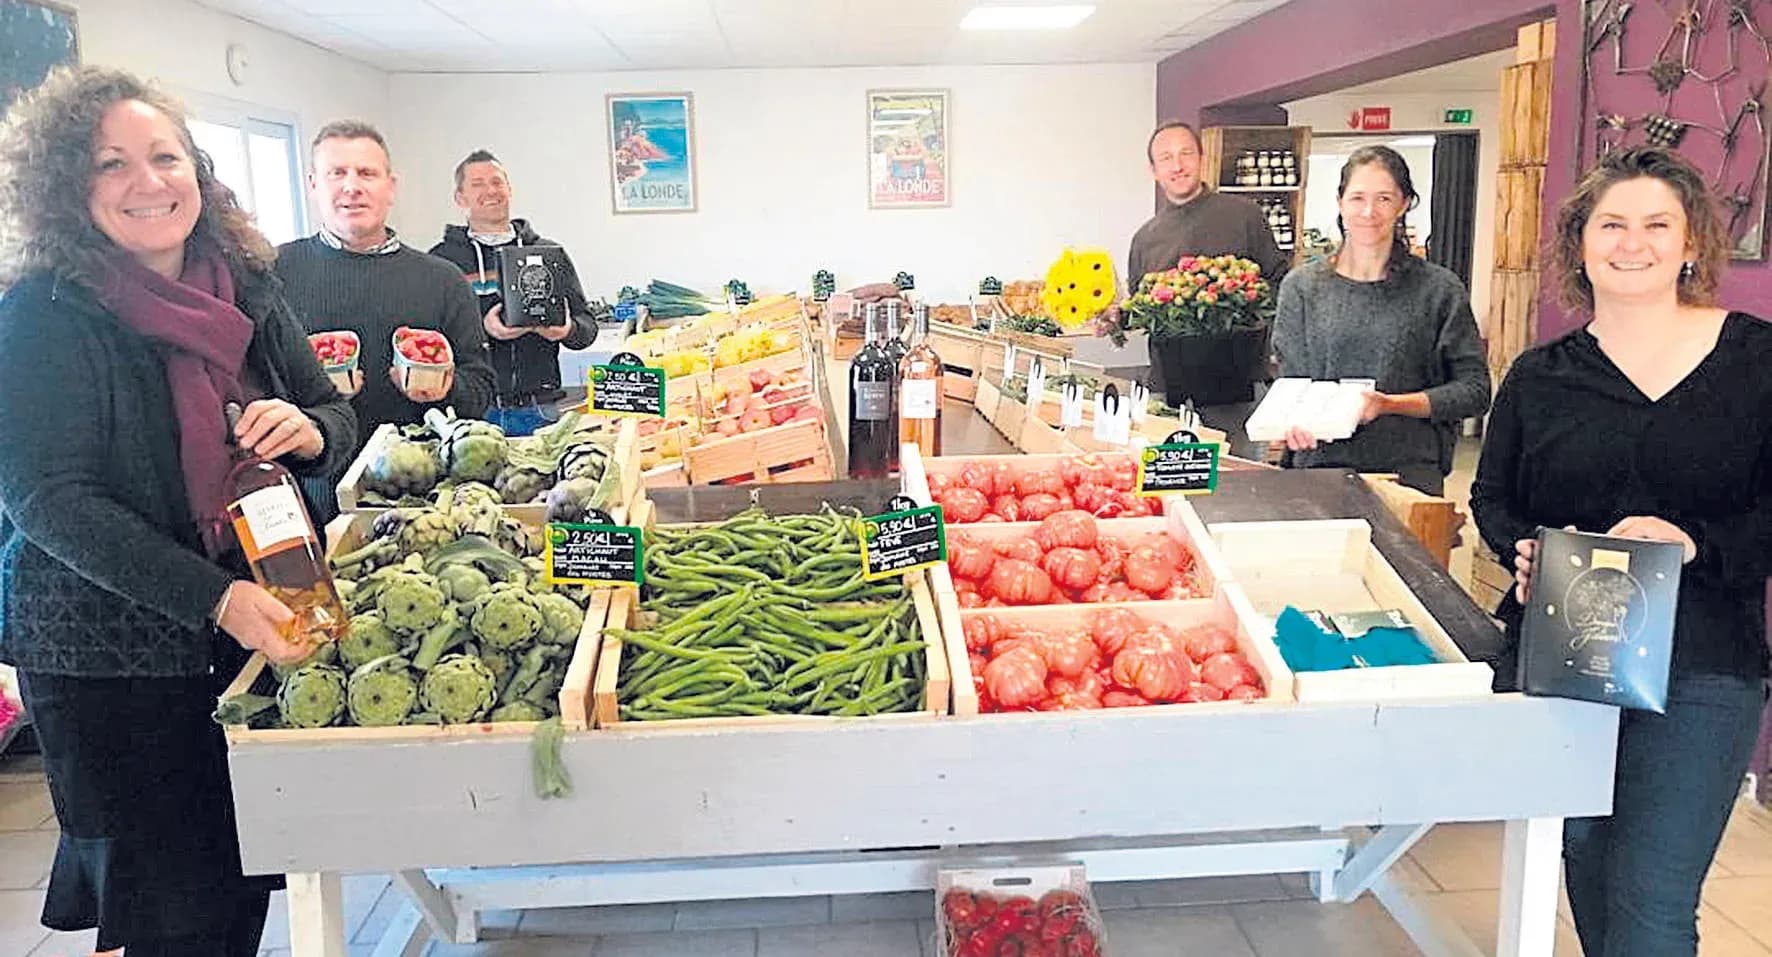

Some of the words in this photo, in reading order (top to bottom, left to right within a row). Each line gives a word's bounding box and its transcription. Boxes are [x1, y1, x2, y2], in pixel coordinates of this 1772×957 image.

[621, 184, 638, 199] LA
[641, 183, 684, 199] LONDE
[899, 180, 944, 194] LONDE
[890, 498, 911, 512] 1kg
